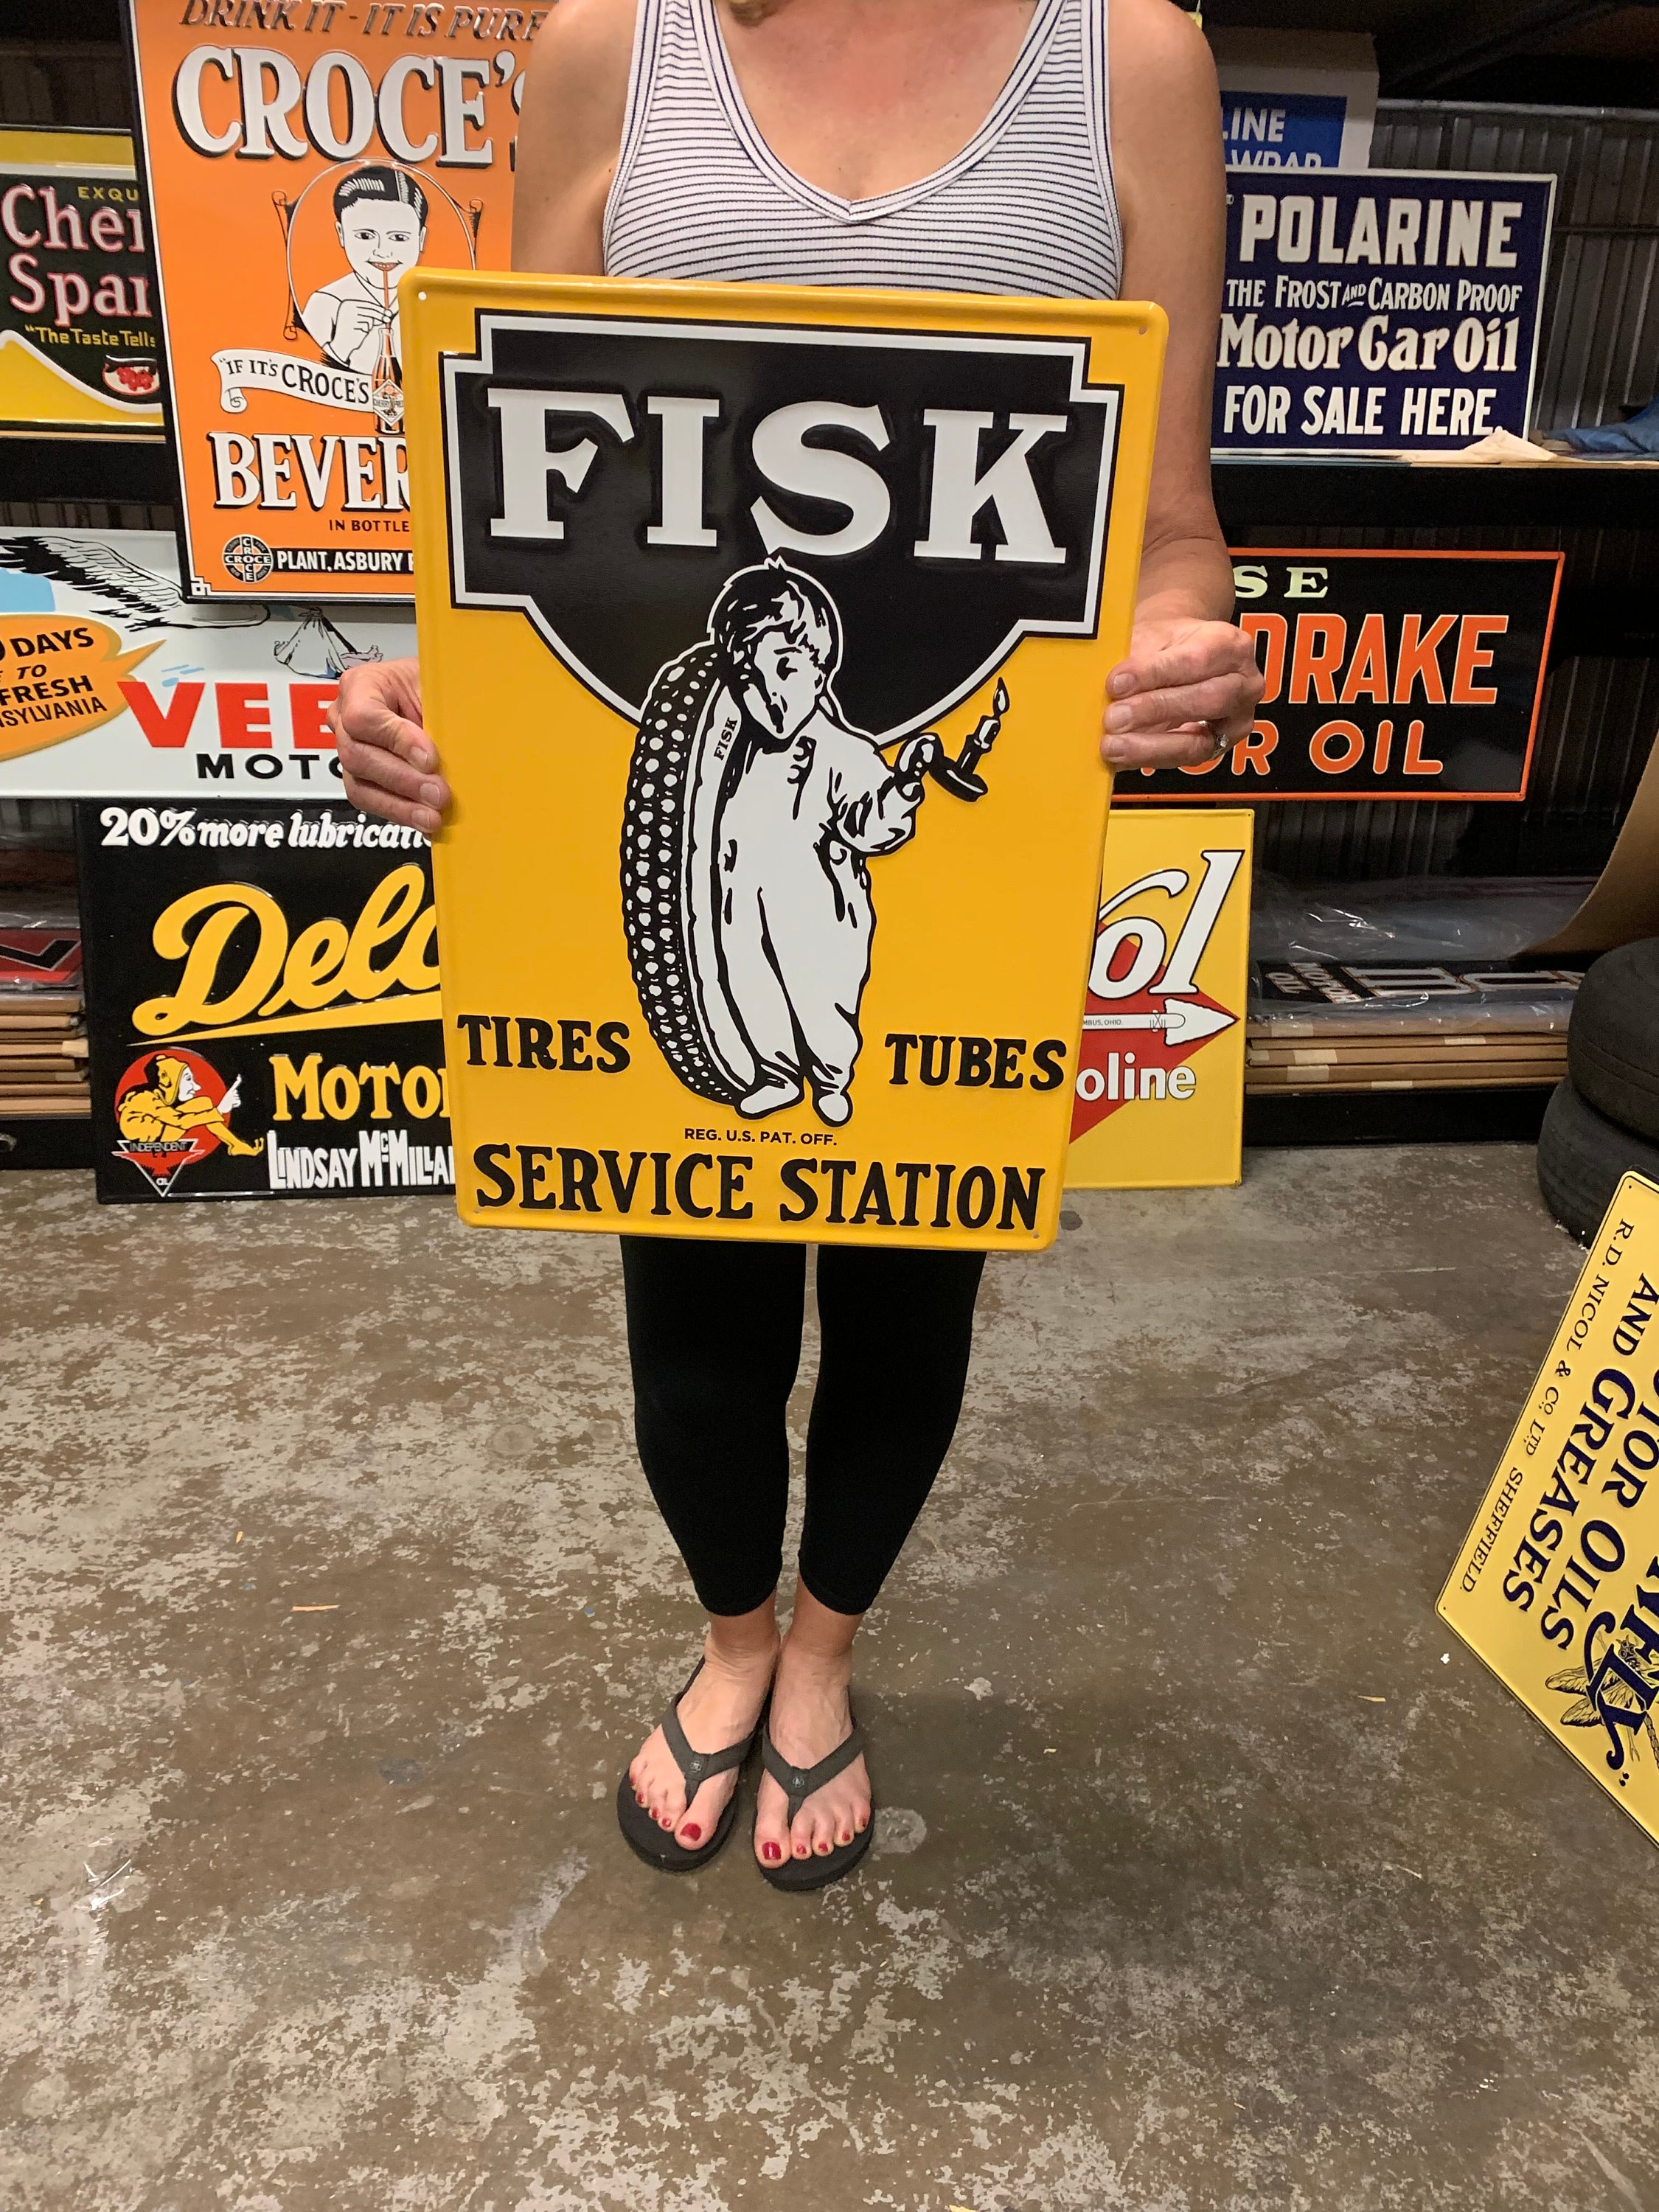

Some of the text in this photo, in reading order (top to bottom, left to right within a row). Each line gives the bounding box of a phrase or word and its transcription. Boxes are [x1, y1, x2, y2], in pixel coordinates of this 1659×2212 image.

[178, 0, 296, 30] DRINK
[304, 1, 347, 32] IT
[362, 3, 406, 35] IT
[406, 3, 444, 38] IS
[1239, 194, 1523, 268] POLARINE
[1226, 275, 1522, 313] THE FROST AND CARBON PROOF
[70, 328, 119, 346] Taste
[1217, 313, 1520, 372] Motor Car Oil
[250, 359, 279, 377] IT'S
[282, 364, 369, 405] CROCE'S
[1222, 386, 1503, 437] FOR SALE HERE.
[487, 388, 1068, 565] FISK
[330, 519, 345, 531] IN
[224, 554, 271, 564] CROCE
[278, 551, 333, 572] PLANT,
[333, 551, 403, 571] ASBURY
[10, 627, 94, 658] DAYS
[1240, 613, 1509, 704] DRAKE
[16, 664, 47, 680] TO
[714, 717, 738, 761] FISK
[1309, 718, 1444, 776] OIL
[198, 819, 285, 849] more
[288, 809, 432, 849] lubricati
[456, 1014, 631, 1074] TIRES
[884, 1033, 1066, 1092] TUBES
[1075, 1051, 1197, 1102] oline
[129, 1142, 188, 1152] INDEPENDENT
[267, 1130, 358, 1189] LINDSAY
[684, 1128, 838, 1146] REG. U.S. PAT. OFF.
[473, 1144, 1046, 1231] SERVICE STATION
[1567, 1273, 1610, 1351] NICOL
[1556, 1359, 1571, 1377] &
[1503, 1273, 1659, 1612] AND GREASES
[1459, 1467, 1523, 1593] SHEFFIELD.
[1540, 1519, 1626, 1651] OILS
